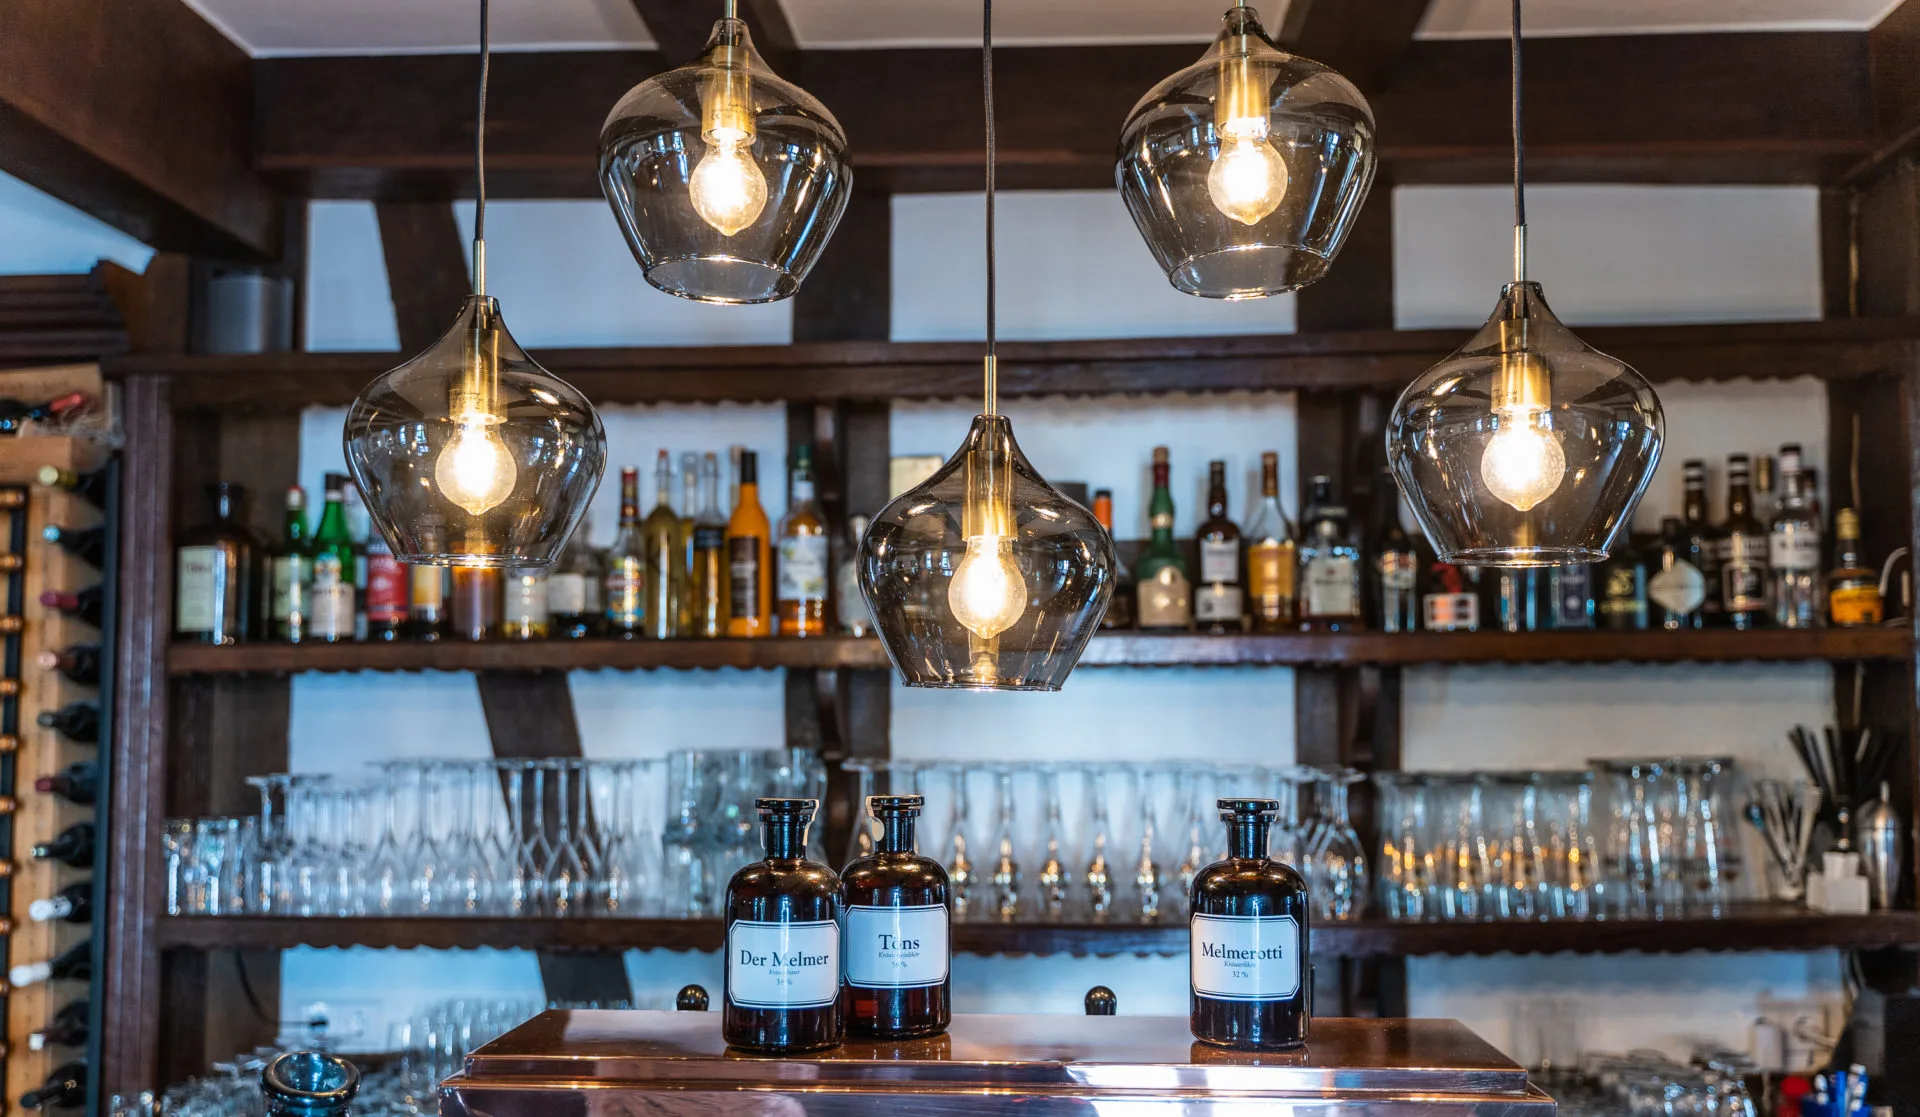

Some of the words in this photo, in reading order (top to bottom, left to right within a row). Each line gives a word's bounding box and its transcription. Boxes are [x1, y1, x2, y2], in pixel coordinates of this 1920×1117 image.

[878, 934, 920, 950] Töns
[1201, 941, 1283, 960] Melmerotti
[740, 949, 767, 966] Der
[772, 951, 829, 967] Melmer
[1232, 970, 1240, 978] 32
[1241, 970, 1249, 978] %
